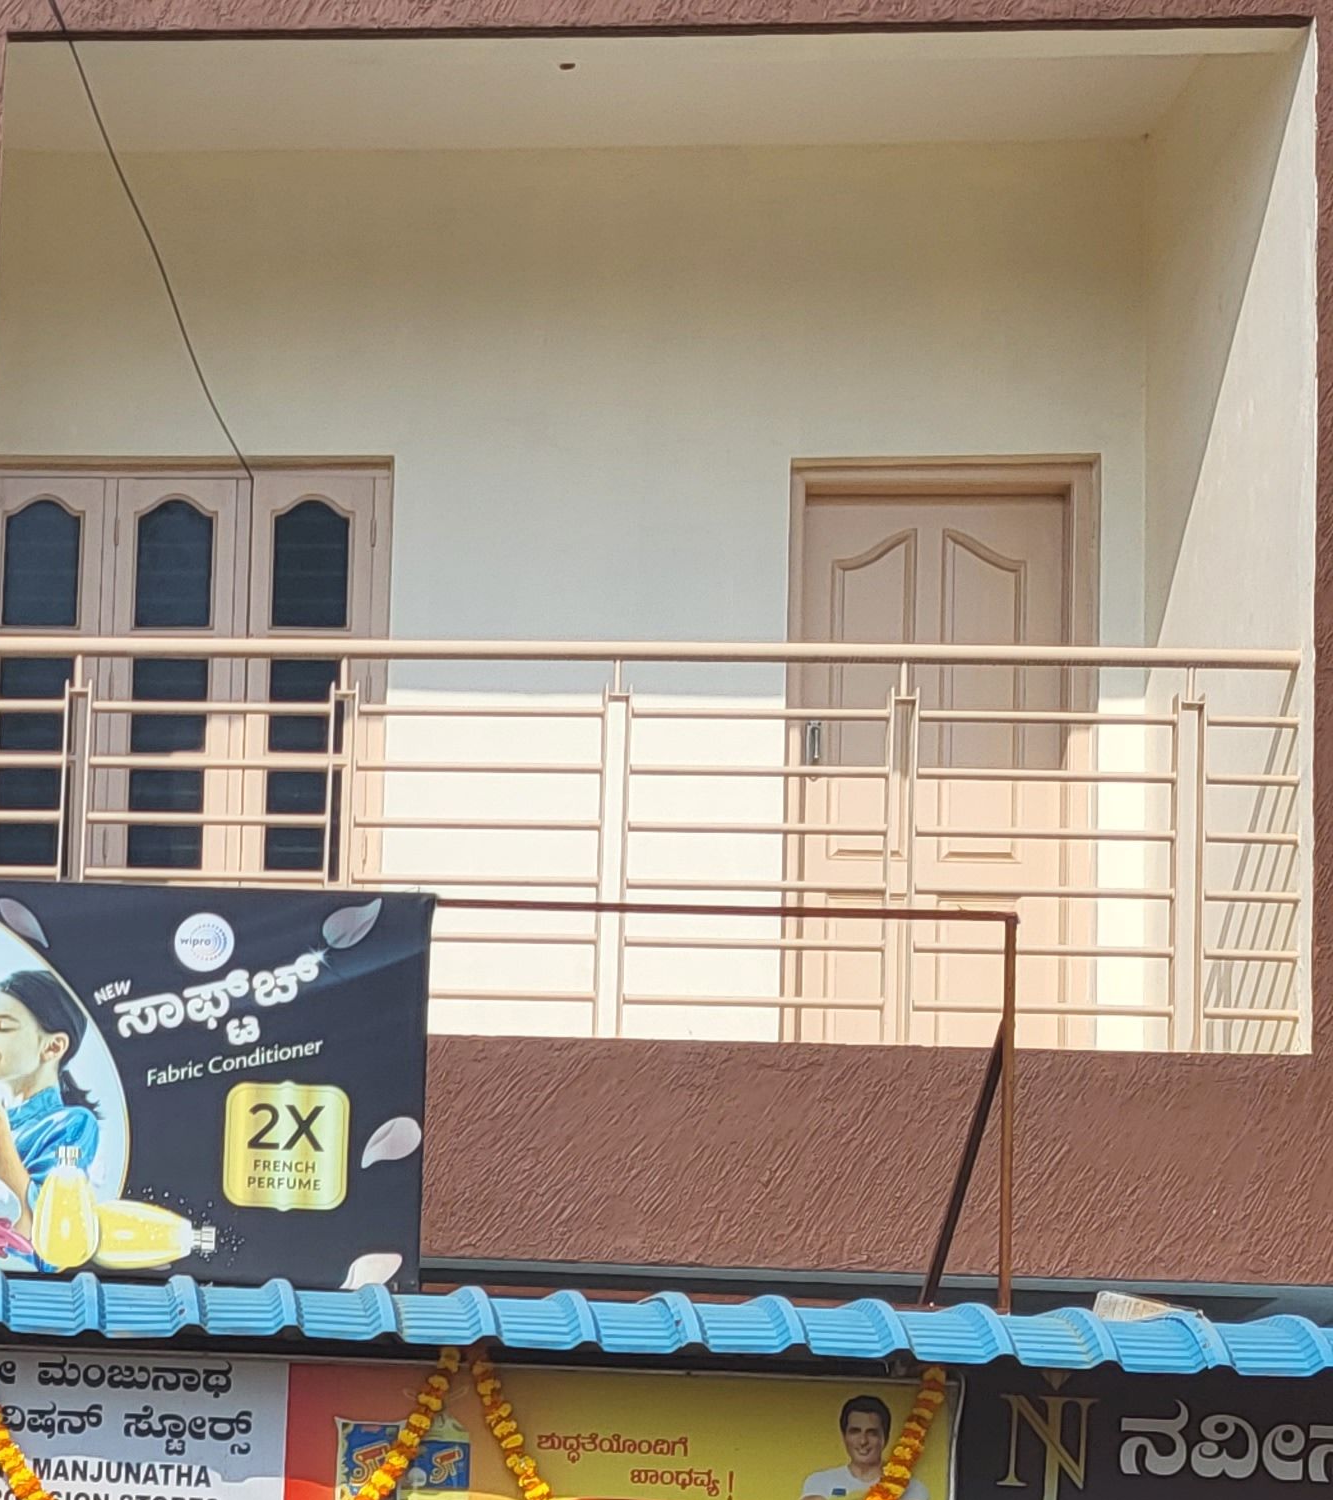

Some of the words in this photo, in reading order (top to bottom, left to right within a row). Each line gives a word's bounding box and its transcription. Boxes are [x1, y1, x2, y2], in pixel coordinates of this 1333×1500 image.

[180, 936, 211, 948] wipro
[93, 979, 131, 1005] NEW
[147, 1061, 203, 1087] Fabric
[208, 1040, 323, 1074] Conditioner
[247, 1103, 325, 1152] 2X
[253, 1159, 316, 1174] FRENCH
[247, 1176, 321, 1192] PERFUME
[37, 1354, 233, 1399] ಮಂಜುನಾಥ
[33, 1457, 212, 1488] MANJUNATHA
